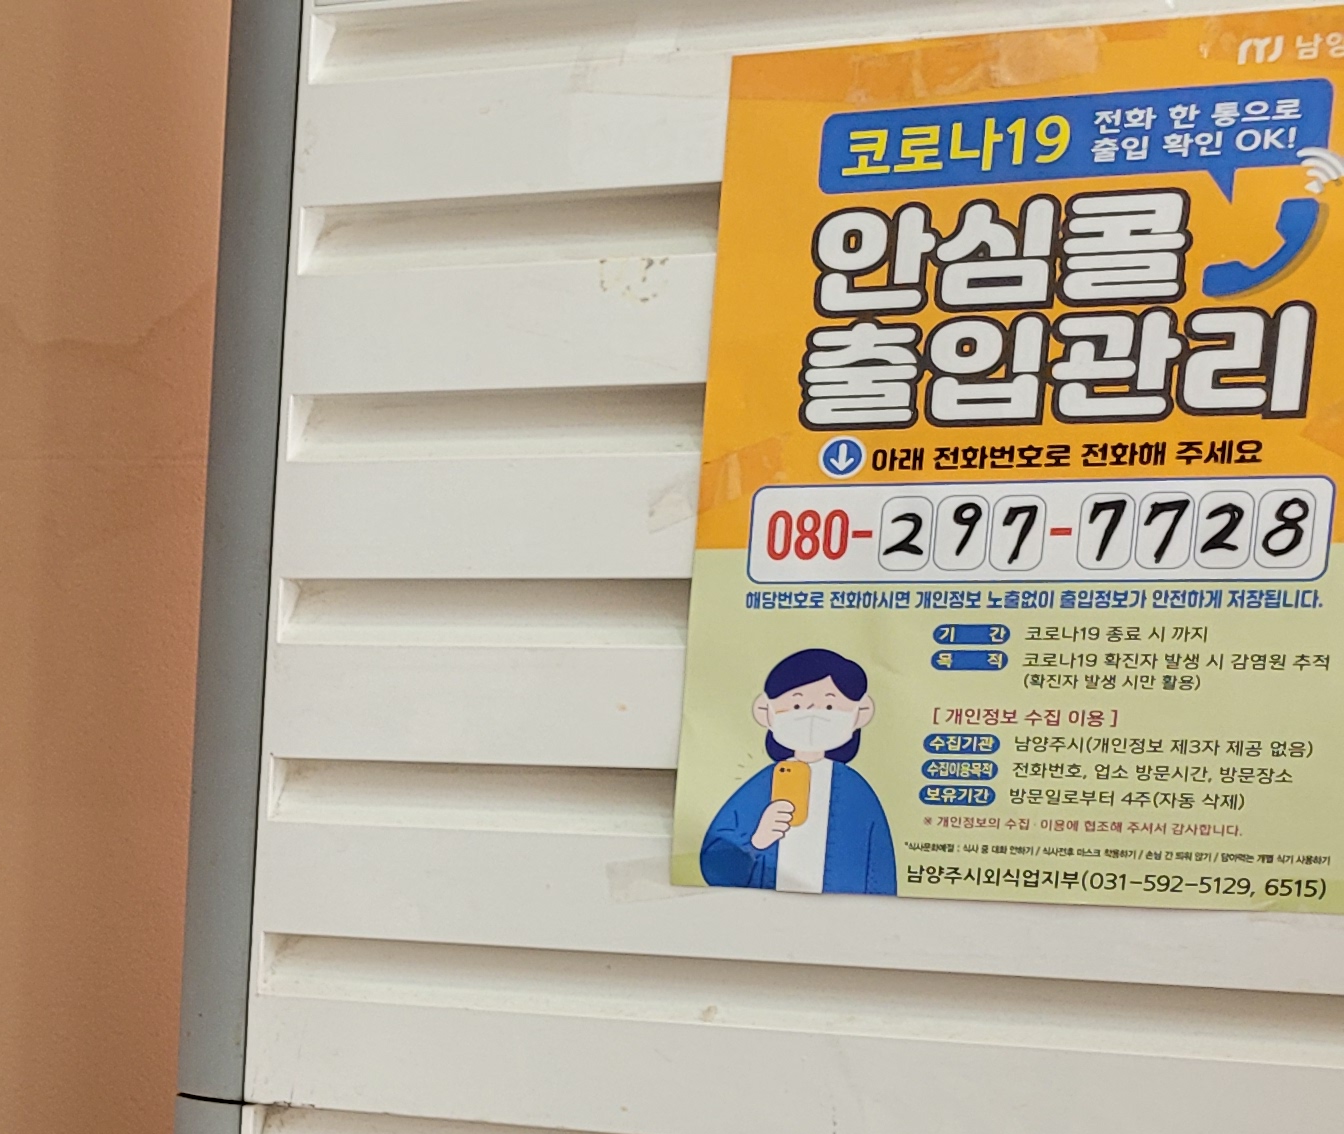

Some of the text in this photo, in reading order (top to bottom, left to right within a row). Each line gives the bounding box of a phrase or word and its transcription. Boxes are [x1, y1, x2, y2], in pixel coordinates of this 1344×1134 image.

[1093, 98, 1302, 134] 전화 한 통으로
[841, 114, 1071, 178] 코로나19
[1090, 127, 1297, 163] 출입 확인 OK!
[814, 188, 1190, 314] 안심콜
[802, 301, 1315, 430] 출입관리
[871, 439, 1264, 472] 아래 전화번호로 전화해 주세요
[745, 589, 1324, 609] 해당번호로 전화하시면 개인정보 노출없이 출입정보가 안전하게 저장됩니다.
[1024, 626, 1208, 643] 코로나19 종료 시 까지
[1022, 653, 1330, 671] 코로나19 확진자 발생 시 감염원 추적
[1023, 673, 1201, 691] (확진자 발생 시만 활용)
[945, 708, 1105, 728] 개인정보 수집 이용
[929, 735, 996, 752] 수집기관
[1014, 735, 1313, 758] 남양주시(개인정보 제3자 제공 없음)
[927, 761, 993, 778] 수집이용목적
[1012, 762, 1293, 784] 전화번호, 업소 방문시간, 방문장소
[924, 787, 990, 804] 보유기간
[1009, 788, 1245, 810] 방문일로부터 4주(자동 삭제)
[936, 816, 1000, 830] 개인정보의
[1005, 817, 1030, 831] 수집
[1040, 819, 1078, 833] 이용에
[1084, 820, 1122, 834] 협조해
[1171, 823, 1243, 837] 감사합니다.
[1264, 878, 1327, 900] 6515)
